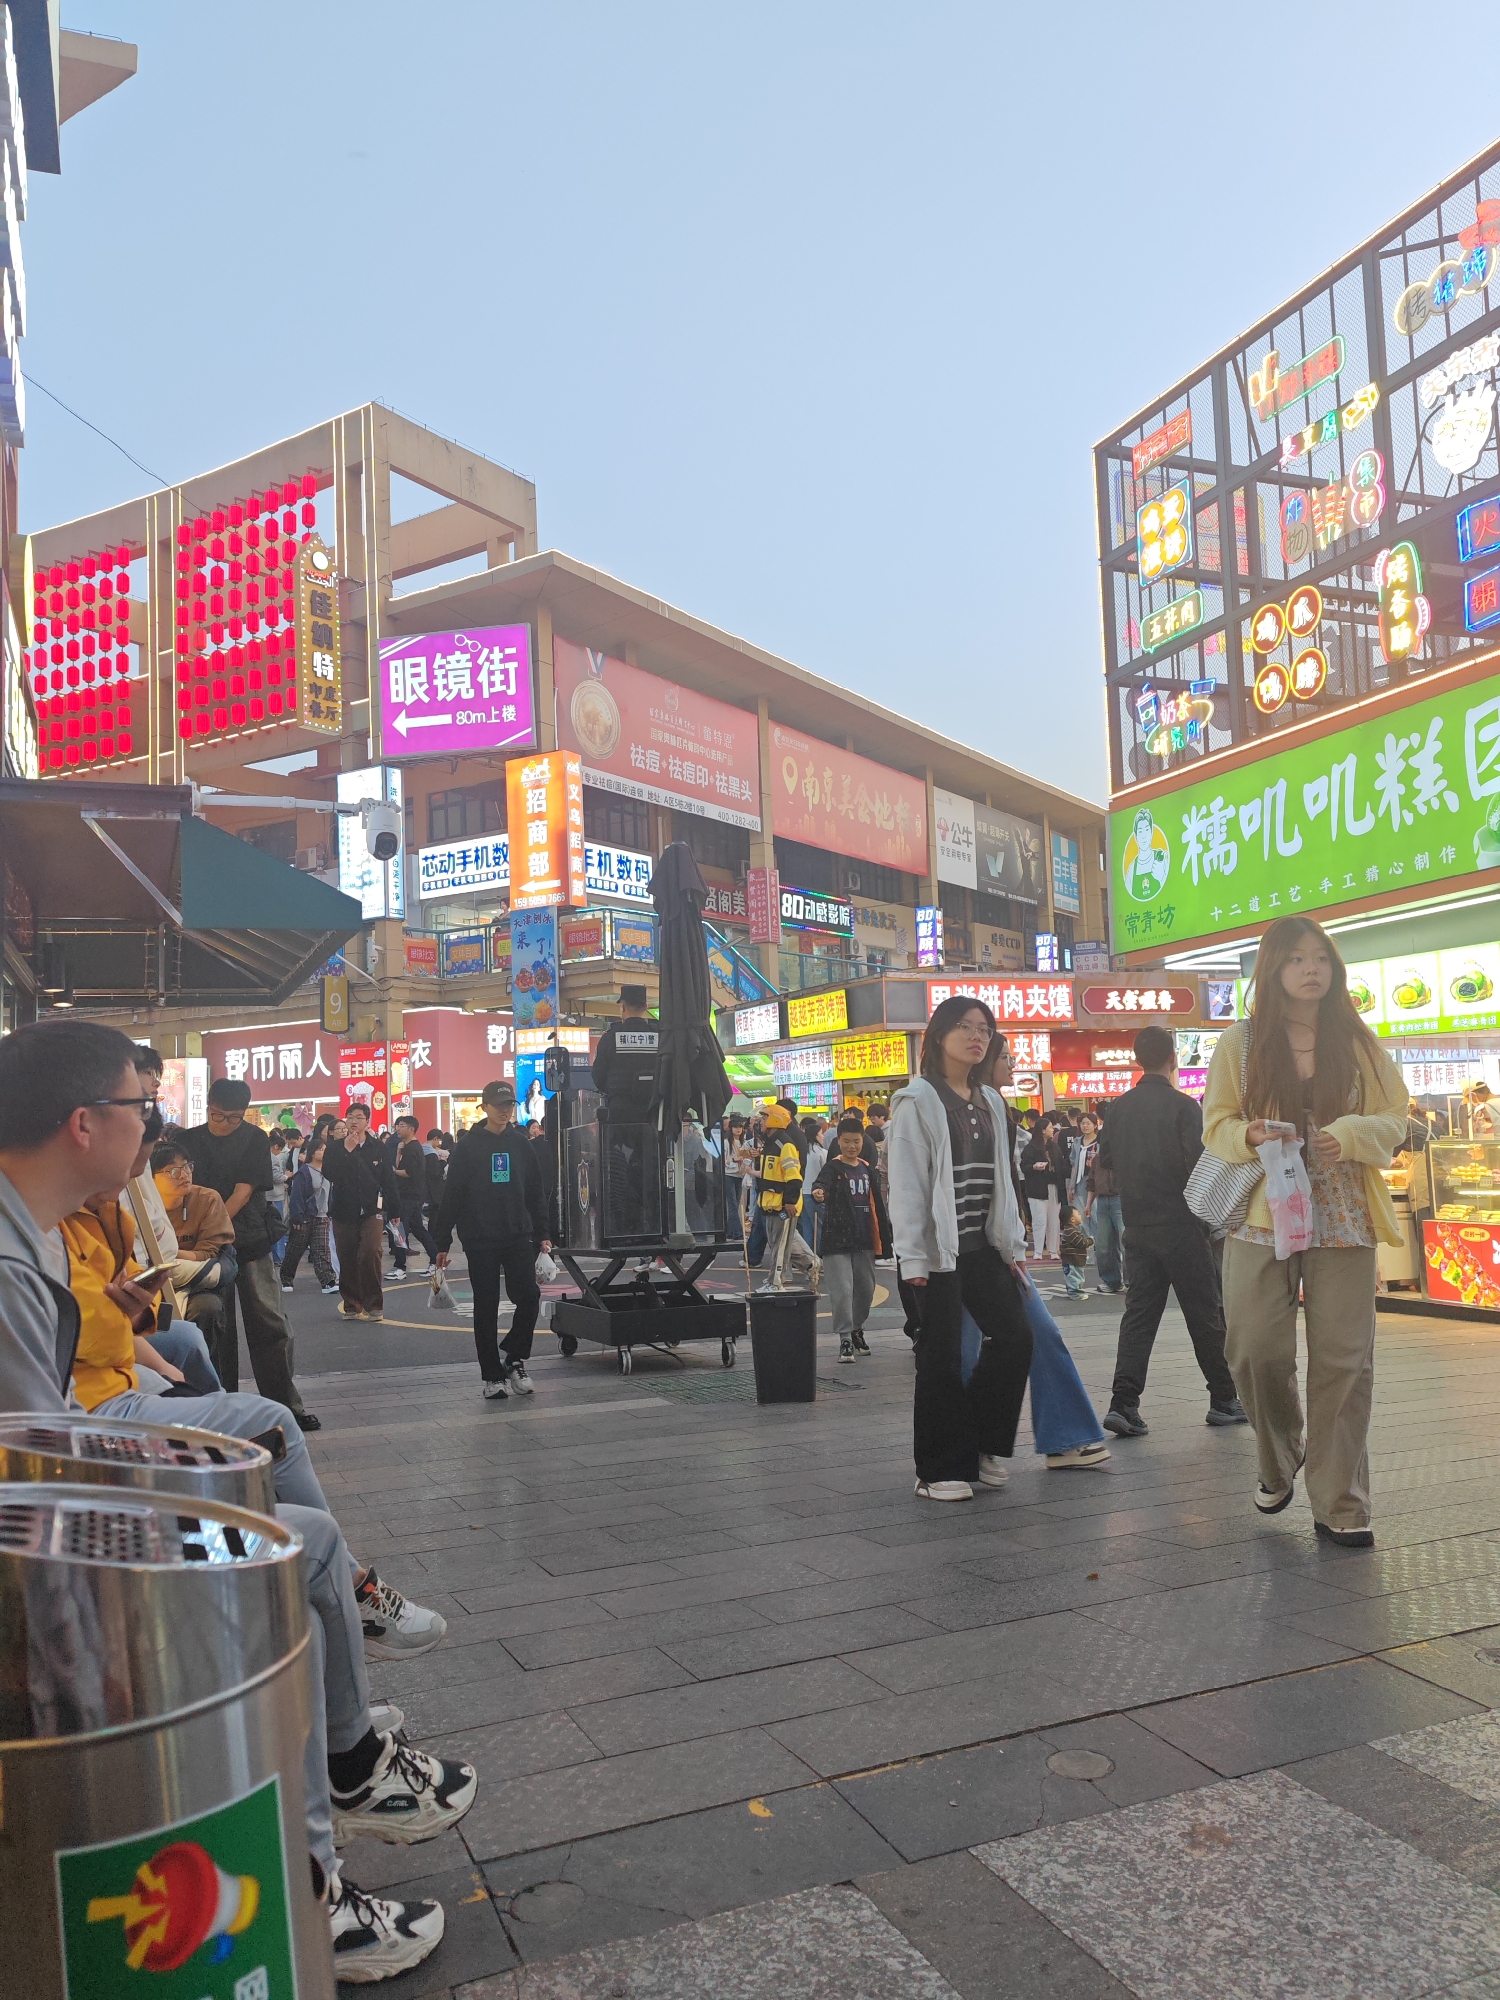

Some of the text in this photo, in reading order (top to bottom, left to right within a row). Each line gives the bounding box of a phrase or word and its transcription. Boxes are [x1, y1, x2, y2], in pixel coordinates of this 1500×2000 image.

[1150, 601, 1195, 642] 五花肉
[389, 646, 518, 706] 眼镜街
[456, 704, 517, 726] 80m上楼
[1161, 690, 1192, 727] 奶茶
[1154, 719, 1200, 756] 研究所
[630, 742, 753, 802] 祛痘 祛痘印 祛黑头
[526, 788, 549, 878] 招商部
[717, 811, 759, 830] 400-1282-400
[951, 821, 973, 848] 公牛
[569, 784, 584, 898] 义乌招商部
[422, 841, 508, 877] 芯动手机数
[1053, 857, 1078, 883] 日丰管
[514, 898, 527, 908] 159
[781, 893, 850, 927] 8D动感影院
[513, 913, 552, 930] 天津刨冰
[1124, 904, 1176, 938] 常青坊
[517, 931, 551, 955] 来了!
[569, 930, 598, 944] 眼镜批发
[621, 931, 648, 944] 文体百货
[1076, 963, 1099, 971] 拍立得
[330, 993, 342, 1014] 9
[226, 1040, 332, 1081] 都市丽人
[411, 1039, 432, 1069] 衣
[835, 1039, 905, 1072] 越越芳燕烤蹄
[1013, 1034, 1050, 1063] 夹馍
[340, 1060, 386, 1078] 雪王推荐
[1412, 1063, 1466, 1087] 香酥炸蘑菇
[1070, 1083, 1106, 1095] 开业优惠
